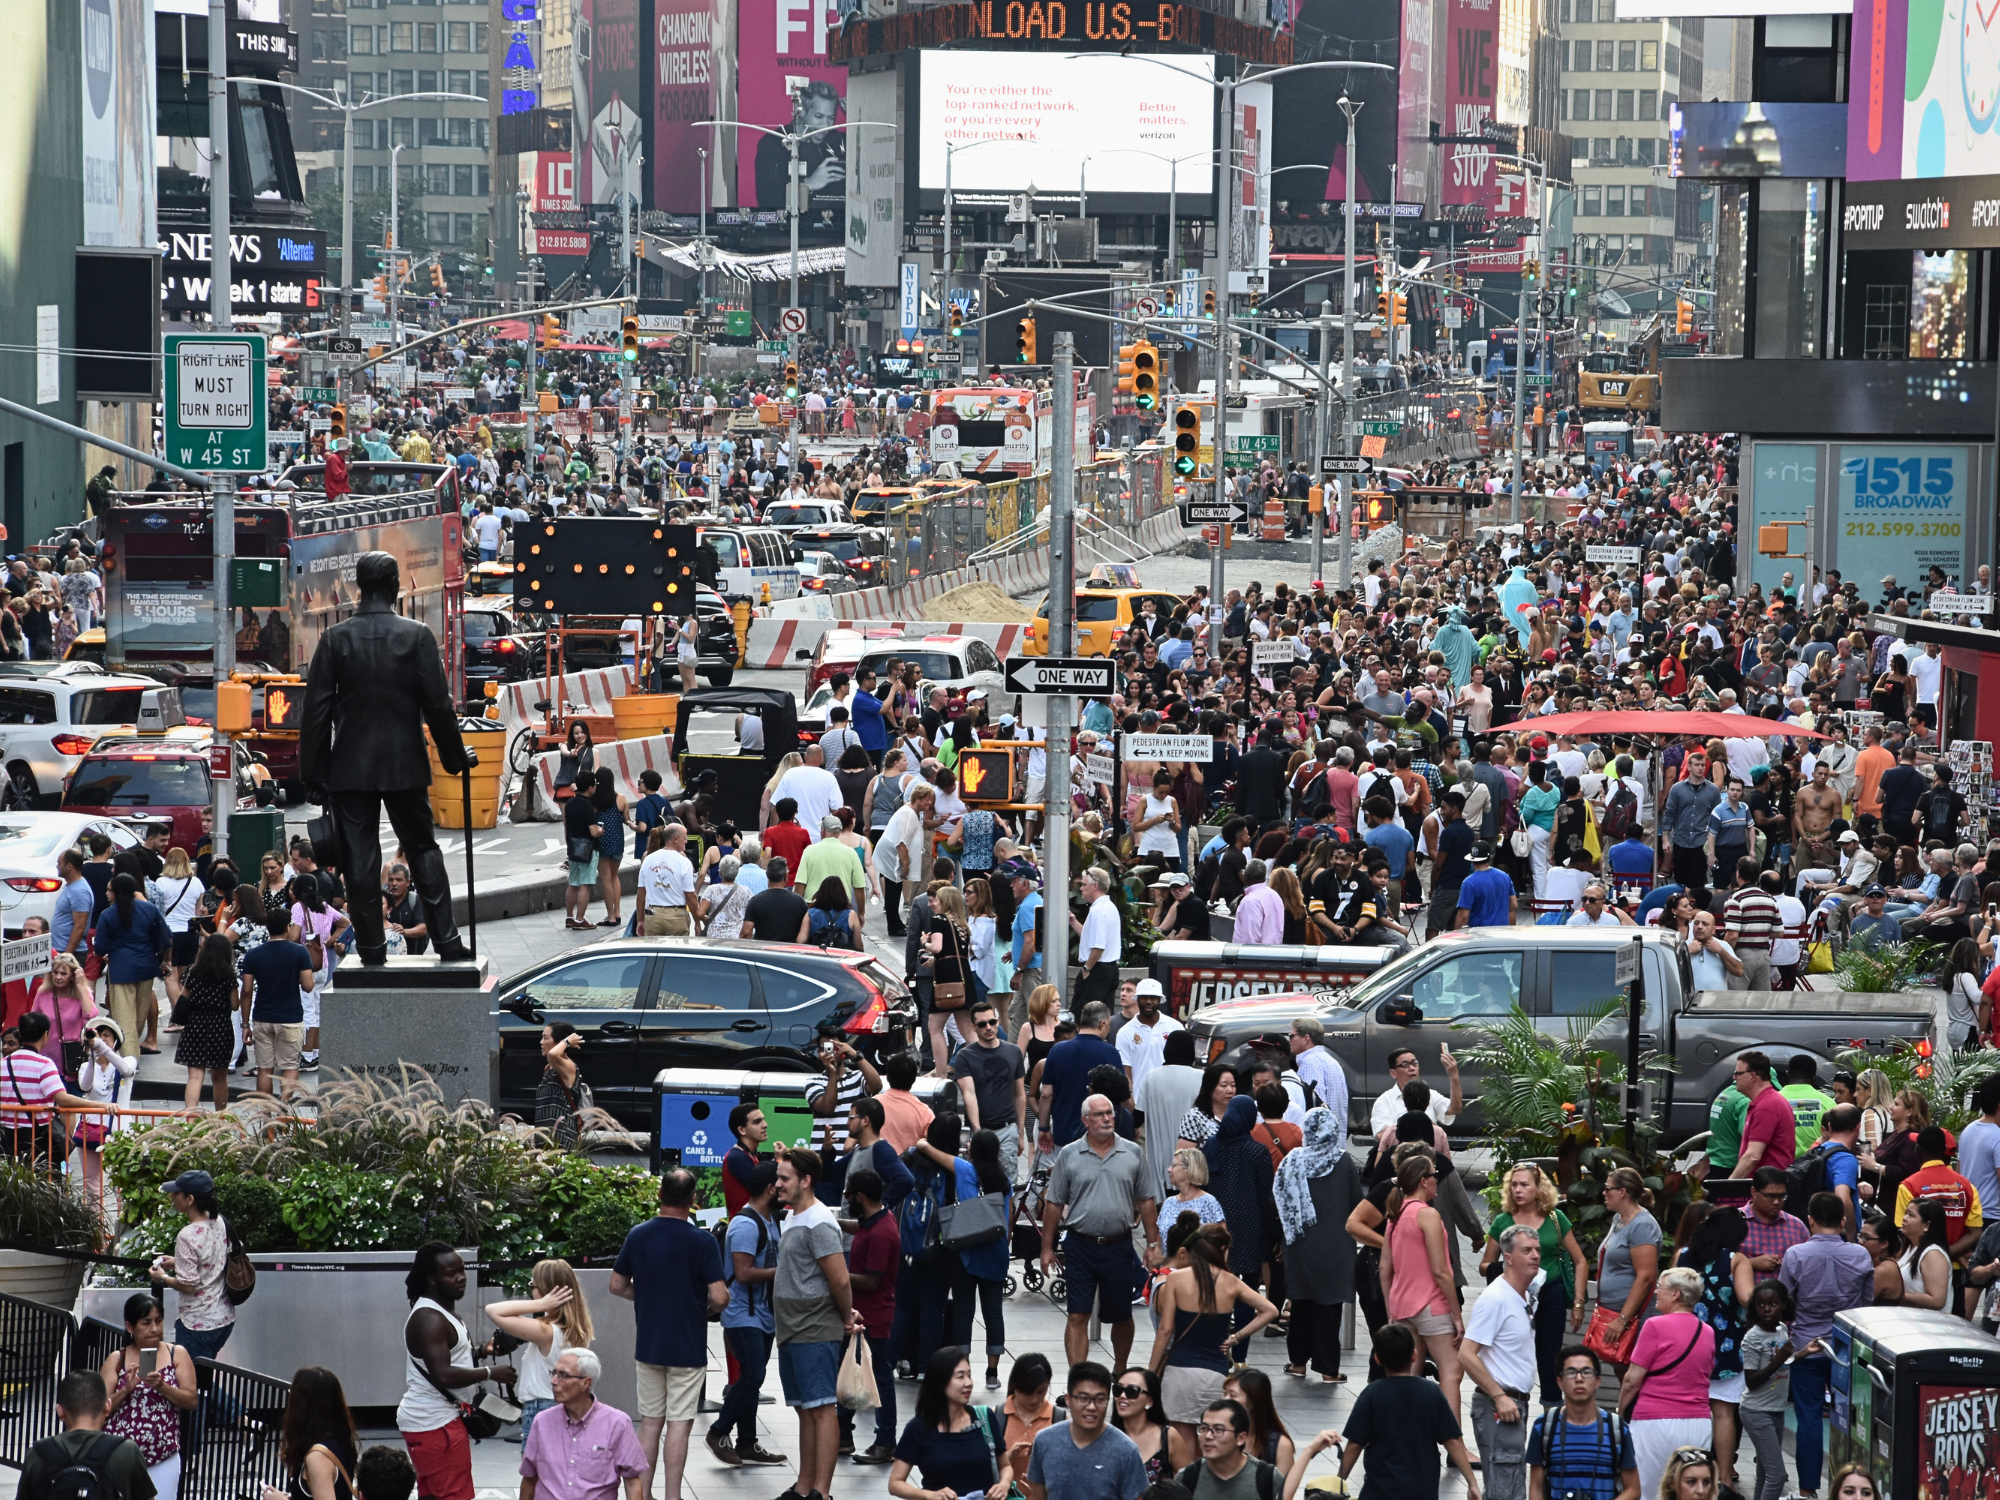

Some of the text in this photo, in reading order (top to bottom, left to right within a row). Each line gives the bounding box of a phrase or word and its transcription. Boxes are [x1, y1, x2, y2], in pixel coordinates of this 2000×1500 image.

[237, 33, 268, 51] THIS
[777, 58, 821, 68] WITHOUT
[1457, 28, 1492, 98] WE
[947, 84, 1053, 96] You're either the
[946, 99, 1018, 112] top-ranked
[1139, 102, 1177, 112] Better
[945, 114, 1041, 129] or you're every
[1139, 115, 1189, 125] matters.
[1455, 103, 1490, 138] WON'T
[944, 129, 1041, 141] other network.
[1139, 131, 1176, 140] verizon
[1454, 144, 1489, 187] STOP
[541, 199, 560, 211] TIMES
[1396, 206, 1419, 215] PRIME
[758, 213, 778, 223] PRIME
[1844, 196, 1944, 231] #POPITUP swatch
[913, 226, 962, 235] SHERWOD
[540, 236, 587, 249] 212.812.5808
[183, 277, 255, 302] Wek
[258, 279, 267, 302] 1
[905, 266, 914, 326] NYPD
[183, 354, 246, 368] RIGHT LANE
[195, 378, 234, 393] MUST
[1603, 382, 1625, 395] CAT
[305, 389, 327, 399] W 45
[181, 404, 248, 417] TURN RIGHT
[1366, 423, 1398, 434] W 45 St
[207, 431, 224, 444] AT
[1241, 438, 1278, 449] W 45 St
[1005, 442, 1030, 451] purity
[181, 448, 251, 465] W 45 ST
[1846, 457, 1954, 495] 1515
[1854, 495, 1953, 509] BROADWAY
[1194, 508, 1230, 517] ONE WAY
[1846, 523, 1961, 537] 212.599.3700
[1934, 596, 1961, 604] PEDESTRIAN
[133, 606, 196, 617] 5 HOURS
[1038, 669, 1103, 685] ONE WAY
[1133, 738, 1209, 747] PEDESTRIAN FLOW ZONE
[1185, 750, 1209, 758] MOVING
[1333, 892, 1354, 919] 7
[4, 940, 49, 960] PEDESTRIAN FLOW ZONE
[4, 960, 30, 976] KEEP MOVING
[438, 1063, 459, 1076] Flag
[685, 1146, 713, 1156] CANS &
[1949, 1356, 1984, 1365] BigBelly
[1925, 1394, 1998, 1436] JERSEY
[1934, 1431, 1986, 1471] BOYS
